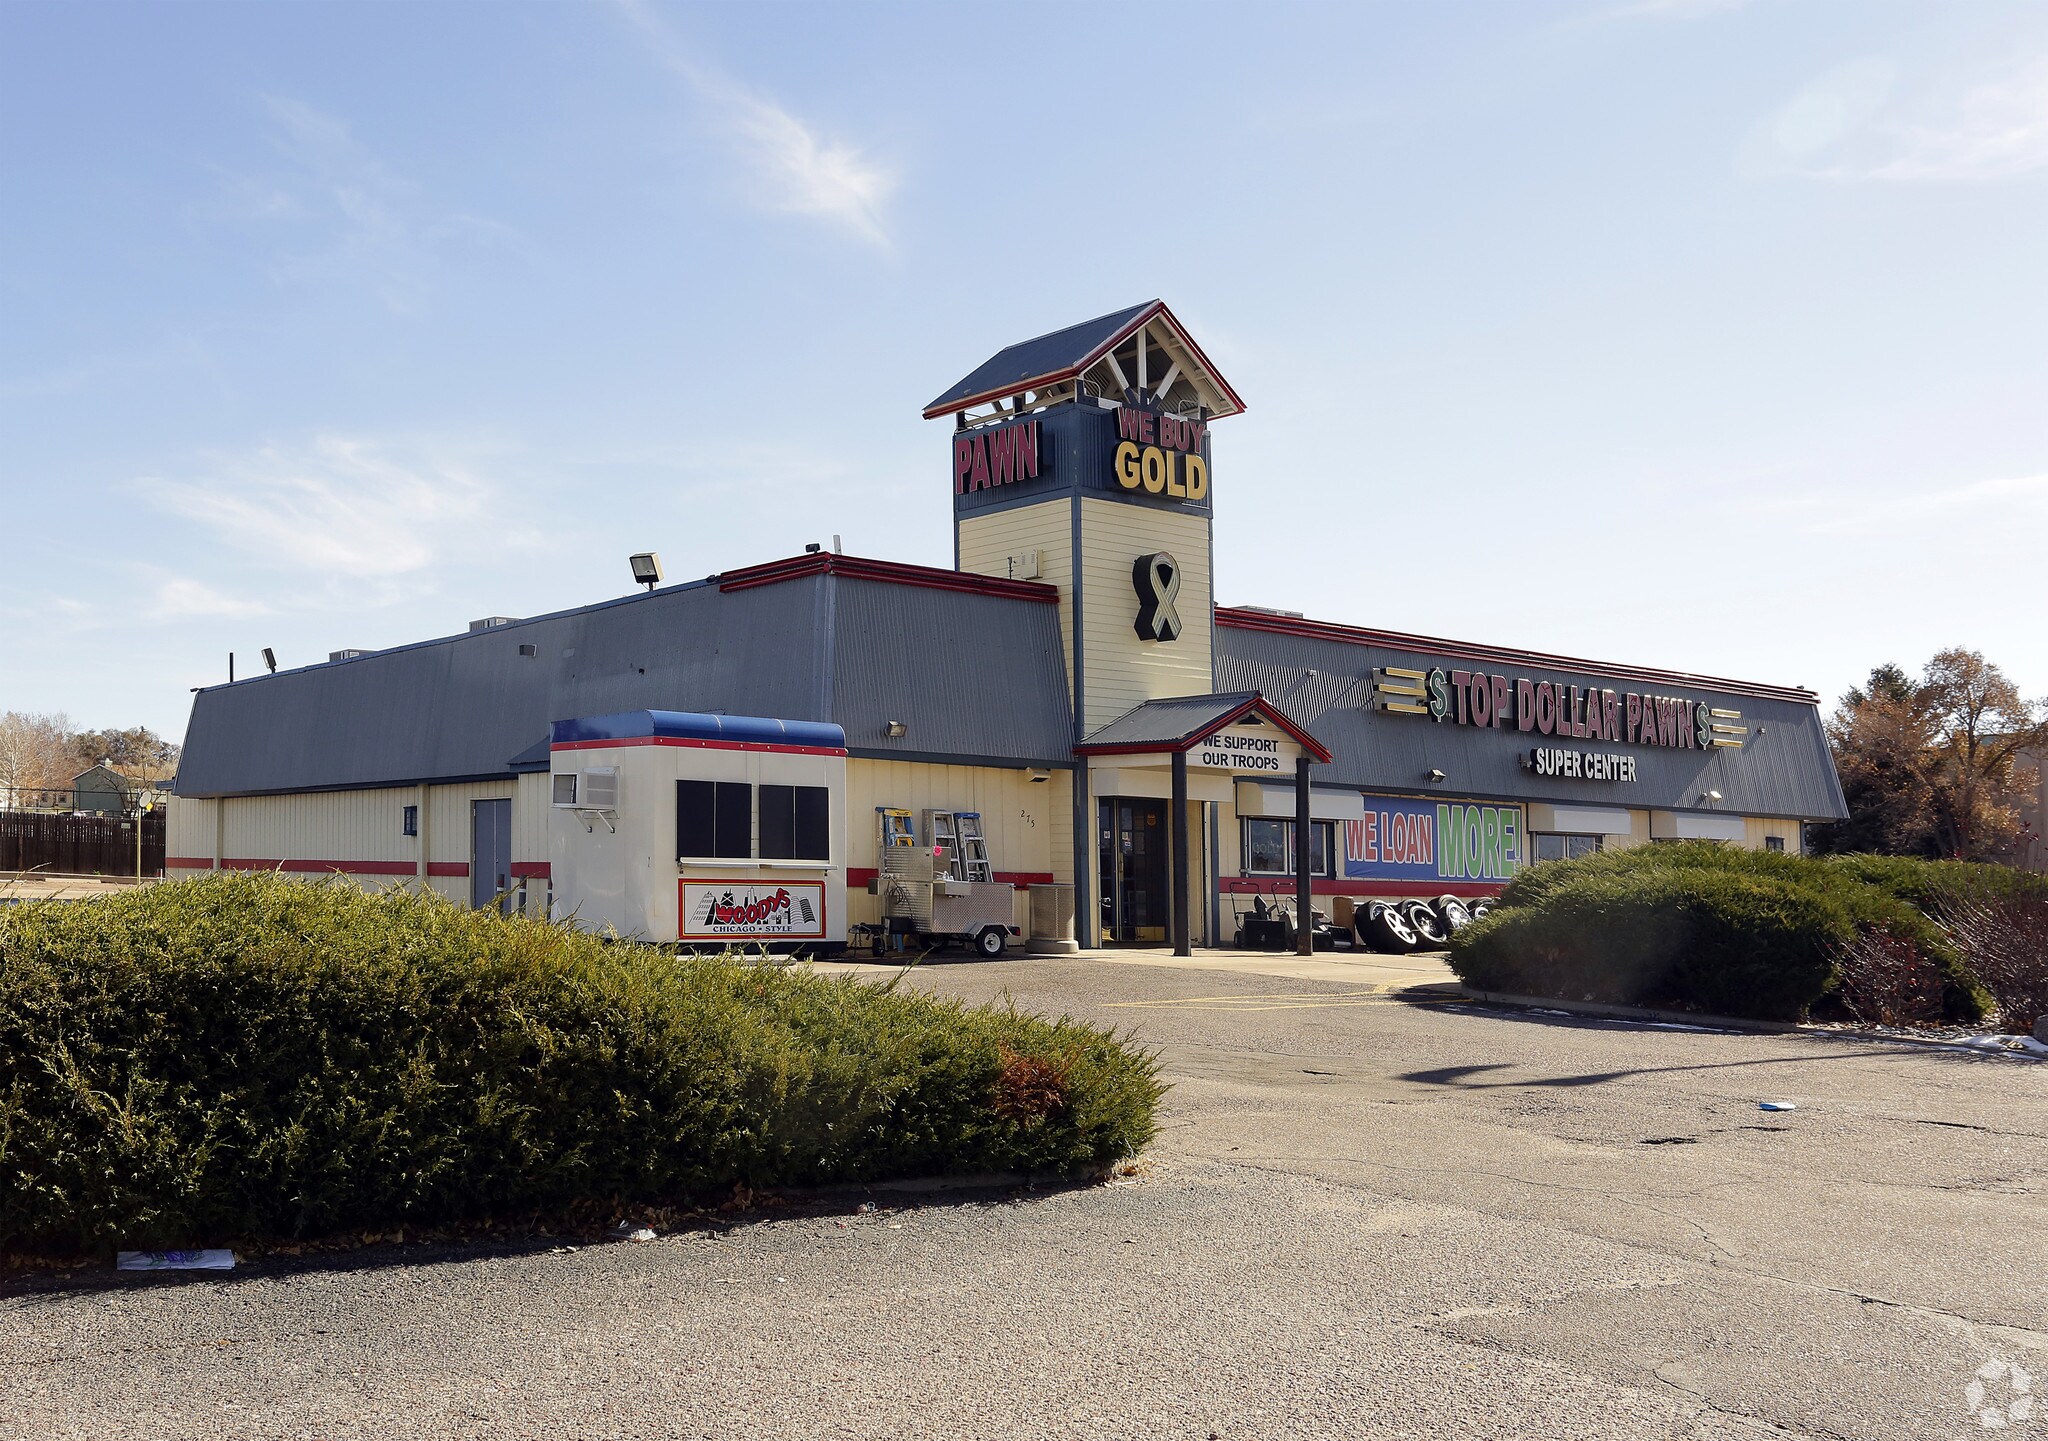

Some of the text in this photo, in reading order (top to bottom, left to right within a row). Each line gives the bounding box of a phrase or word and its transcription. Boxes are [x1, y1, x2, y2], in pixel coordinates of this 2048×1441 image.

[1119, 406, 1204, 453] WE BUY
[955, 420, 1038, 494] PAWN
[1115, 441, 1207, 500] GOLD
[1516, 678, 1620, 741] DOLLAR
[1202, 752, 1279, 770] OUR TROOPS
[1203, 734, 1279, 753] WE SUPPORT
[1536, 748, 1637, 782] SUPER CENTER
[1346, 811, 1433, 865] WE LOAN
[1436, 804, 1521, 880] MORE!
[712, 925, 756, 933] CHICAGO
